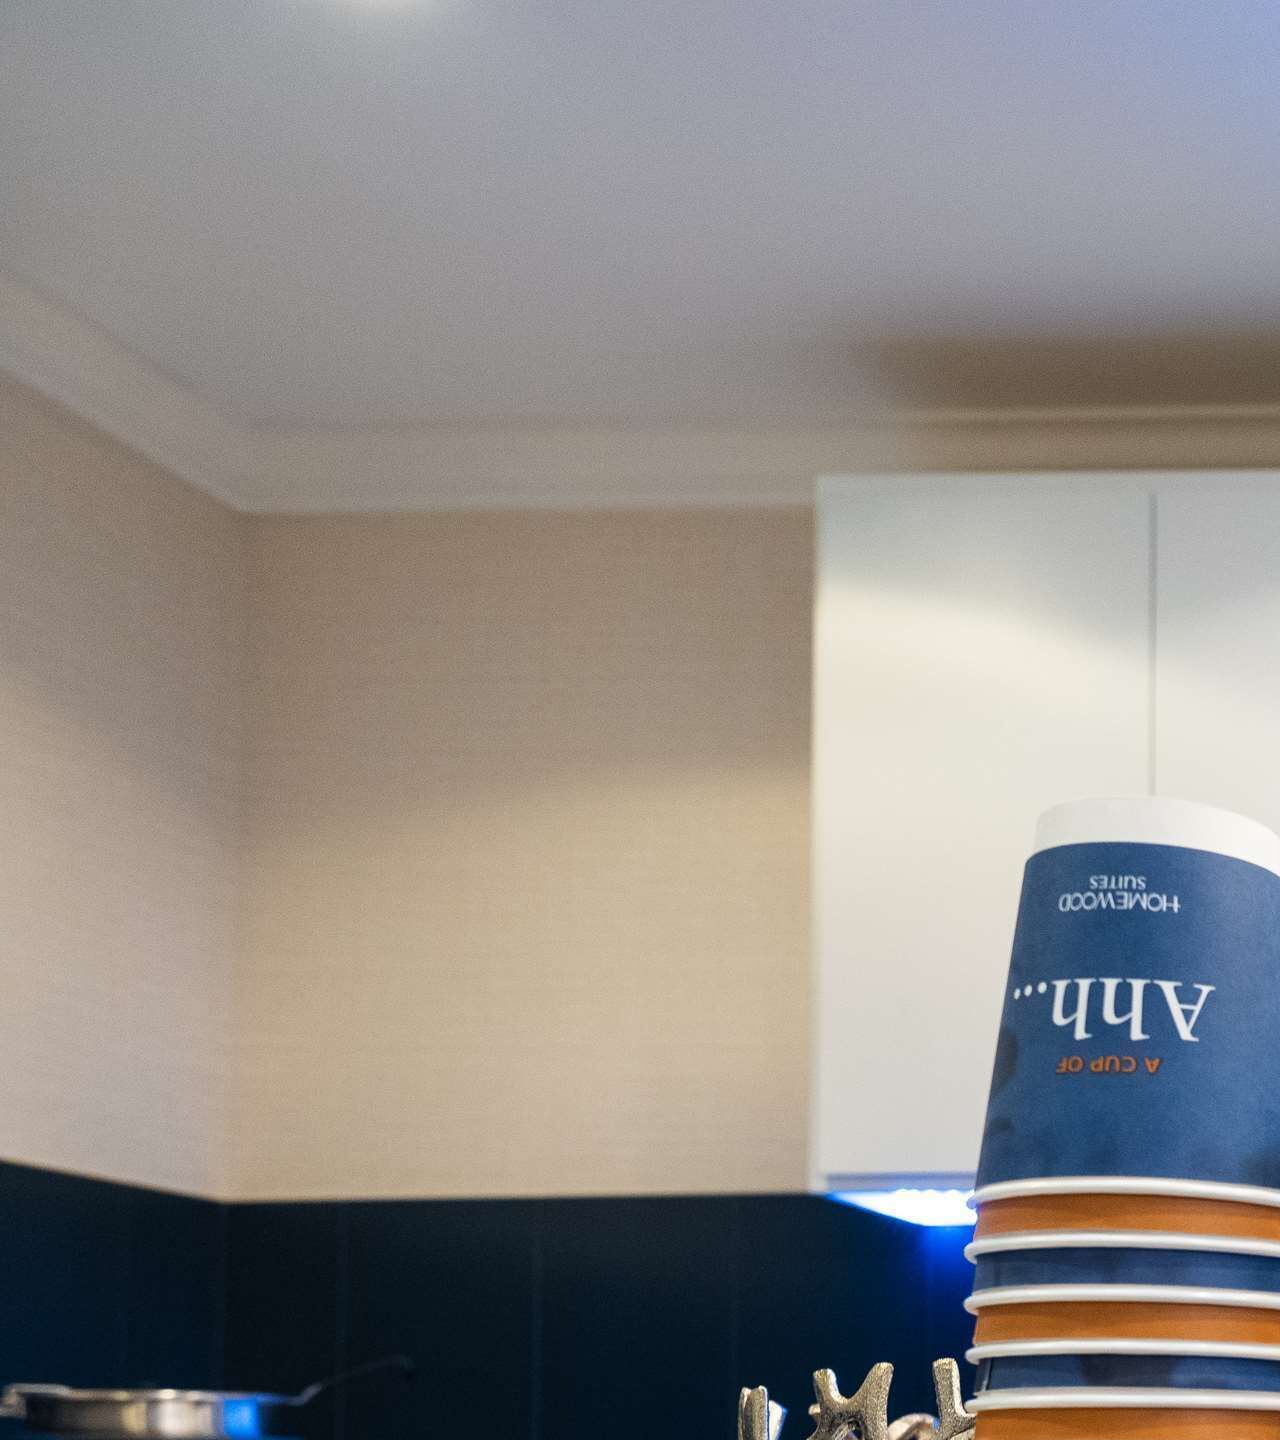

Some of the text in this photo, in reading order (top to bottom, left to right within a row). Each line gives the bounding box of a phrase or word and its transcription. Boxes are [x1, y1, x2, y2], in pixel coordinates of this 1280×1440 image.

[1089, 874, 1146, 890] SUITES
[1058, 891, 1181, 914] HOMEWOOD
[1013, 977, 1216, 1043] Ahh...
[1055, 1055, 1162, 1074] A CUP OF
